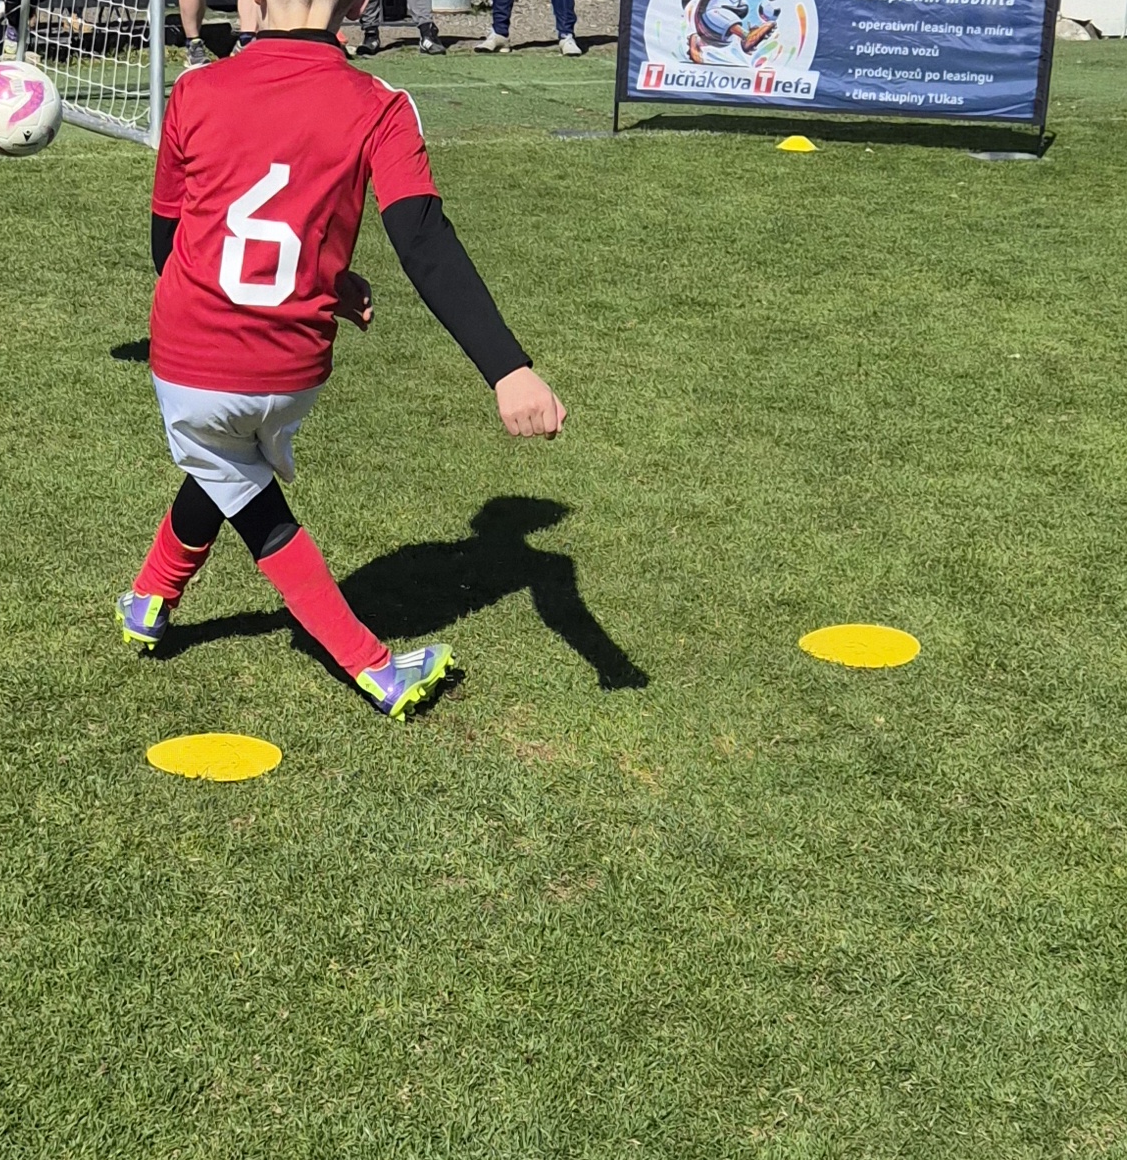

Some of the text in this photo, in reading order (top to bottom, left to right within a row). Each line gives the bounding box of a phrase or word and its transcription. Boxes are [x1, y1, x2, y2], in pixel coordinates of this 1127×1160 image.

[858, 19, 1014, 37] operativní leasing na míru
[856, 42, 940, 57] půjčovna vozů
[646, 63, 812, 95] Tučňákova Trefa
[854, 67, 994, 85] prodej vozů po leasingu
[851, 89, 965, 106] člen skupiny TUkas
[218, 162, 302, 307] 6
